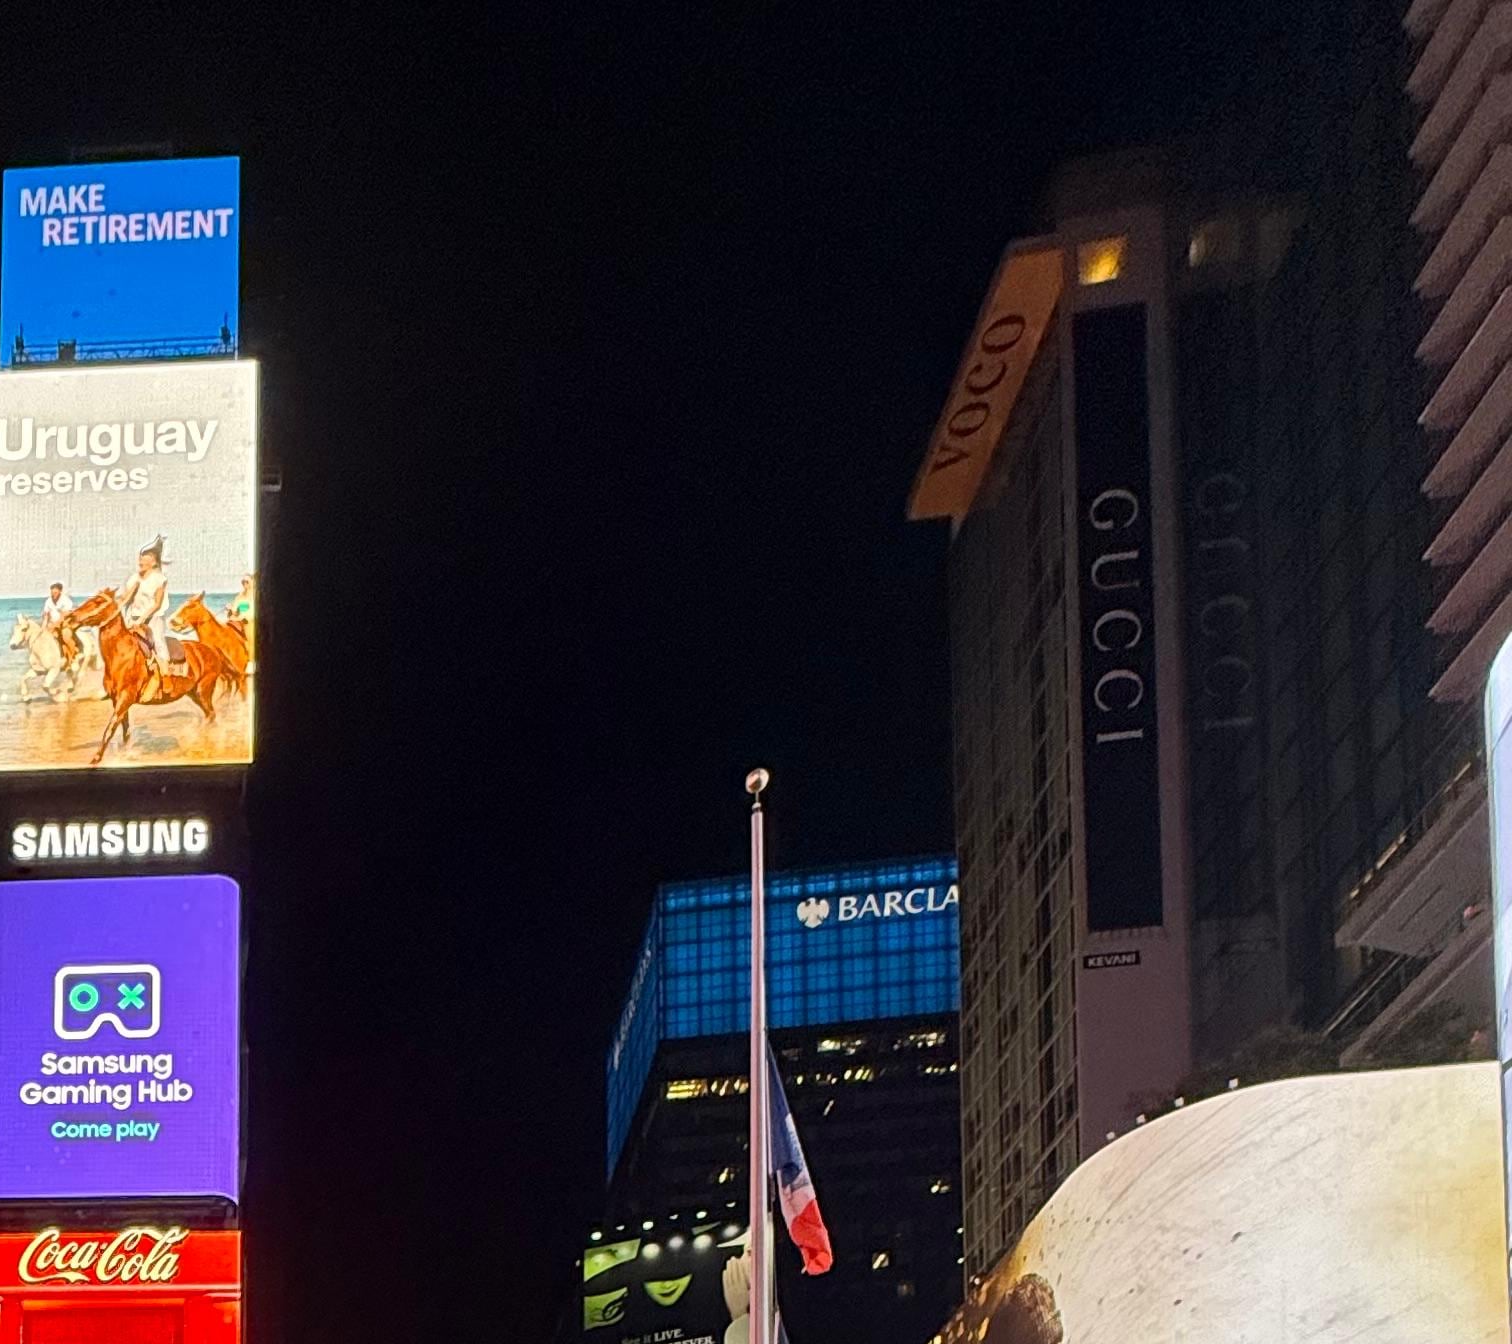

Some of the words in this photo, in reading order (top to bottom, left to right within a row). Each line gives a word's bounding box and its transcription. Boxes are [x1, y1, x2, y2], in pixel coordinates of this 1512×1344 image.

[20, 184, 105, 216] MAKE
[43, 208, 234, 246] RETIREMENT
[1090, 488, 1144, 744] GUCCI
[12, 819, 209, 860] SAMSUNG
[41, 1053, 173, 1079] Samsung
[19, 1079, 132, 1110] Gaming
[138, 1079, 193, 1103] Hub
[51, 1121, 111, 1139] Come
[116, 1119, 160, 1141] play
